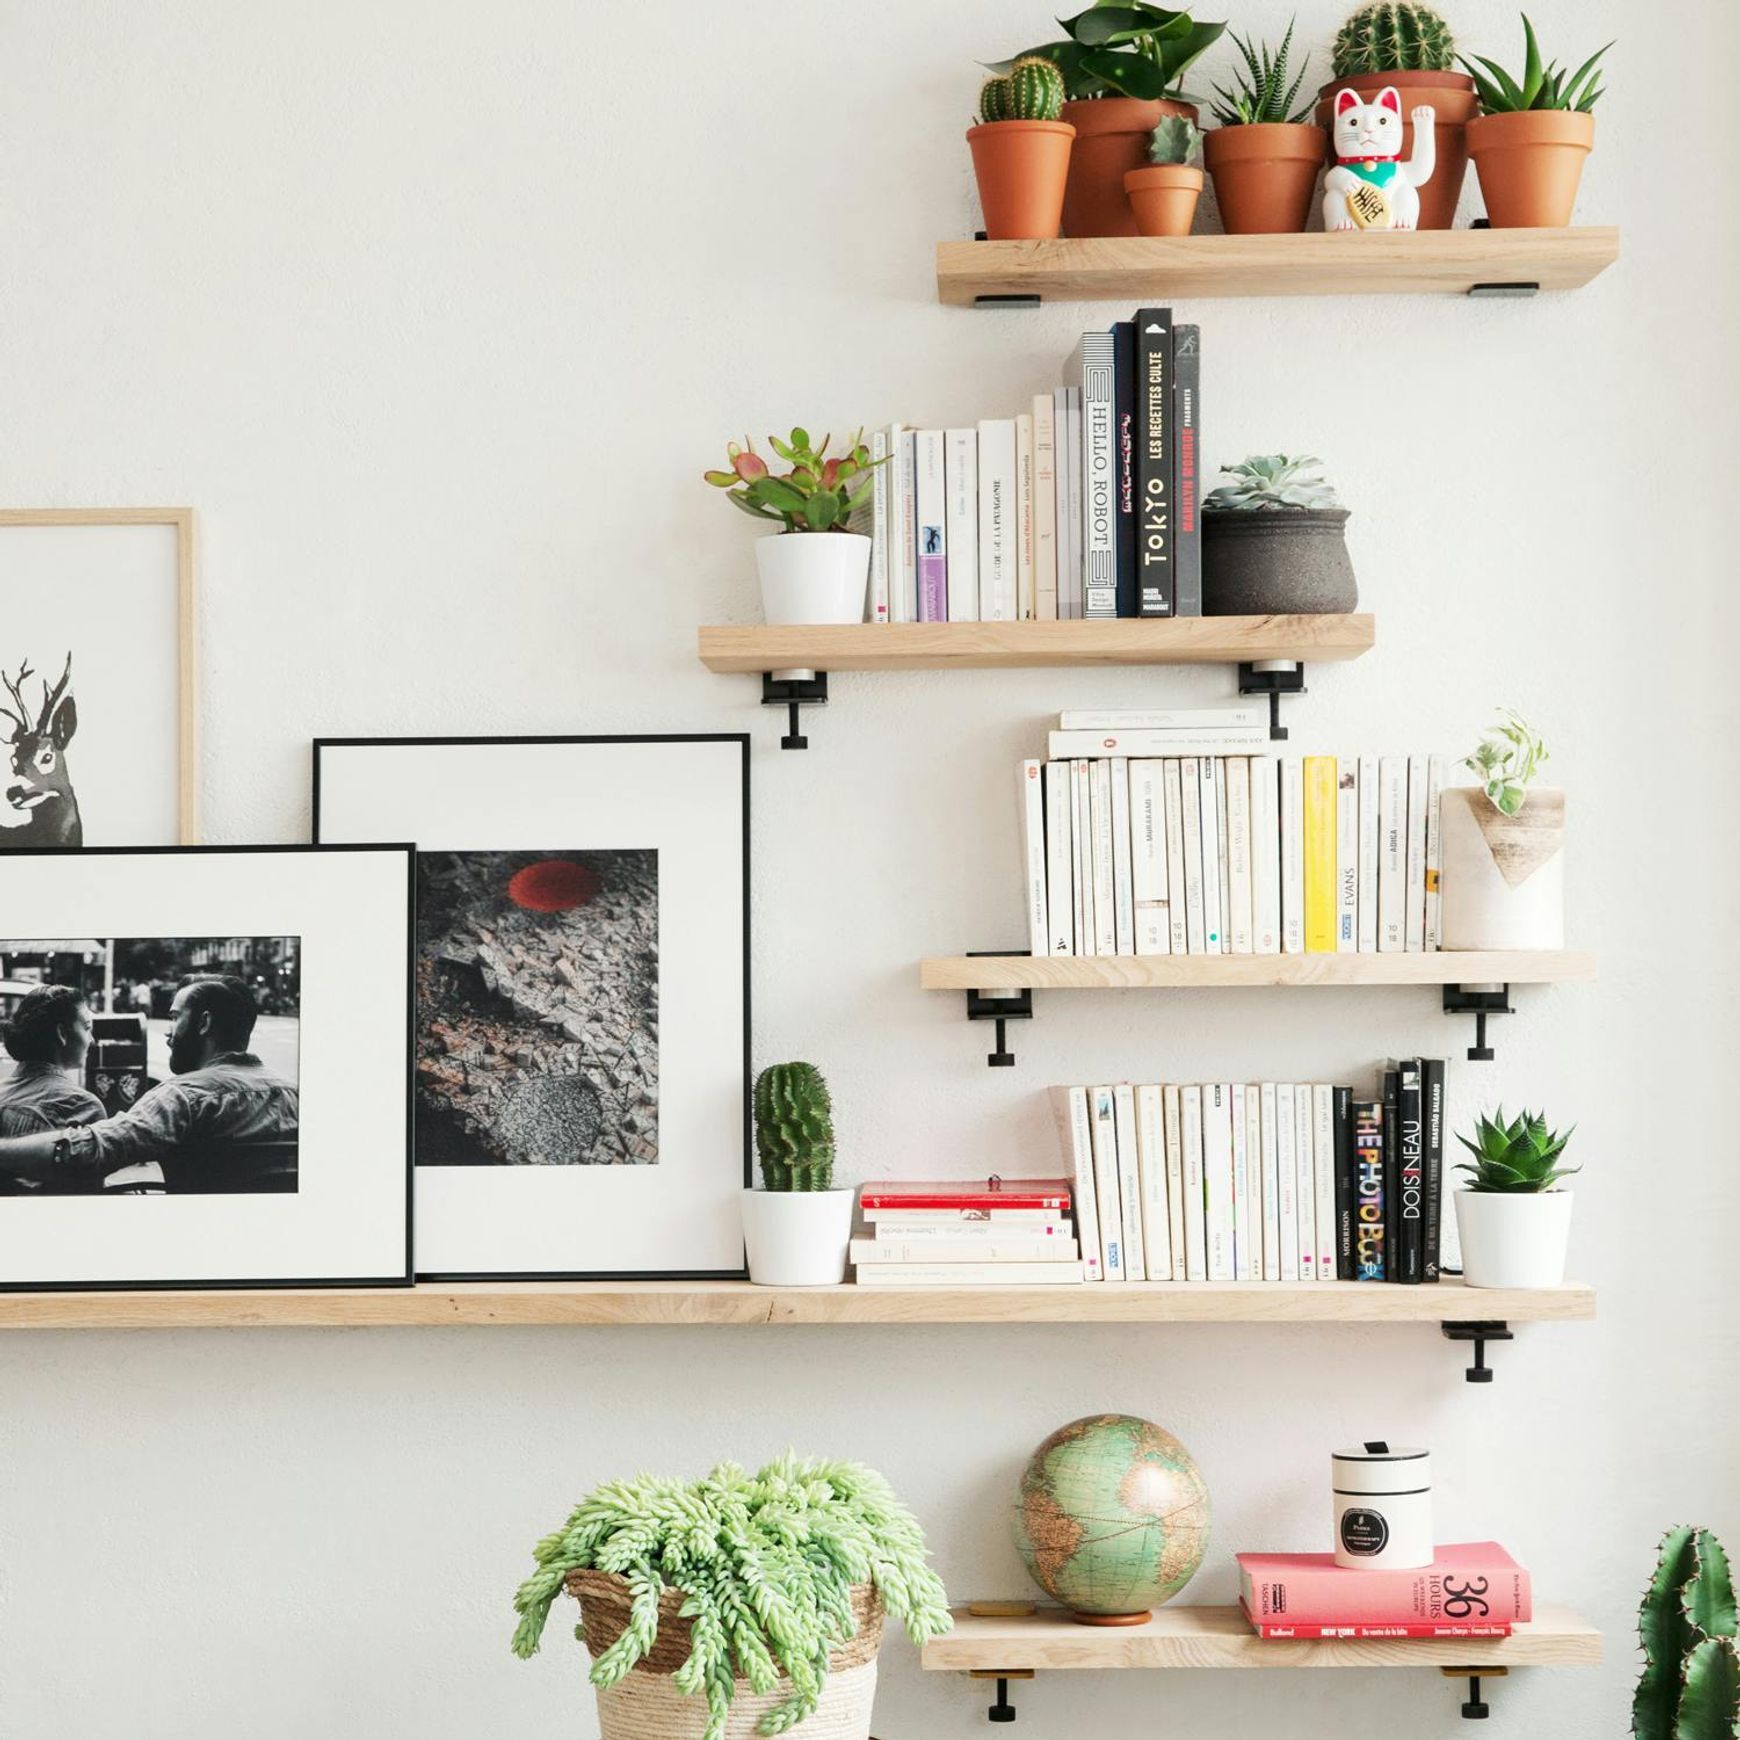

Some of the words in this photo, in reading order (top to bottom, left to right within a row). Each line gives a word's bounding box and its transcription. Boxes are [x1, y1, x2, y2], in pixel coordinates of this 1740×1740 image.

[1149, 352, 1162, 383] CULTE
[1149, 386, 1162, 437] RECETTES
[1092, 407, 1107, 475] HELLO,
[1149, 440, 1162, 459] LES
[993, 479, 1001, 525] PATAGONIE
[1183, 481, 1194, 532] MARILYN
[993, 526, 1001, 537] LA
[1145, 799, 1154, 842] MURAKAMI
[1390, 829, 1398, 853] ADIGA
[1344, 867, 1355, 906] EVANS
[1432, 1083, 1441, 1112] SALGADO
[1430, 1113, 1440, 1148] SEBASTIÃO
[1403, 1120, 1420, 1218] DOISNEAU
[1342, 1210, 1350, 1256] MORRISON
[1429, 1576, 1441, 1619] HOURS
[1443, 1575, 1489, 1618] 36
[1321, 1628, 1336, 1636] NEW
[1337, 1628, 1355, 1638] YORK
